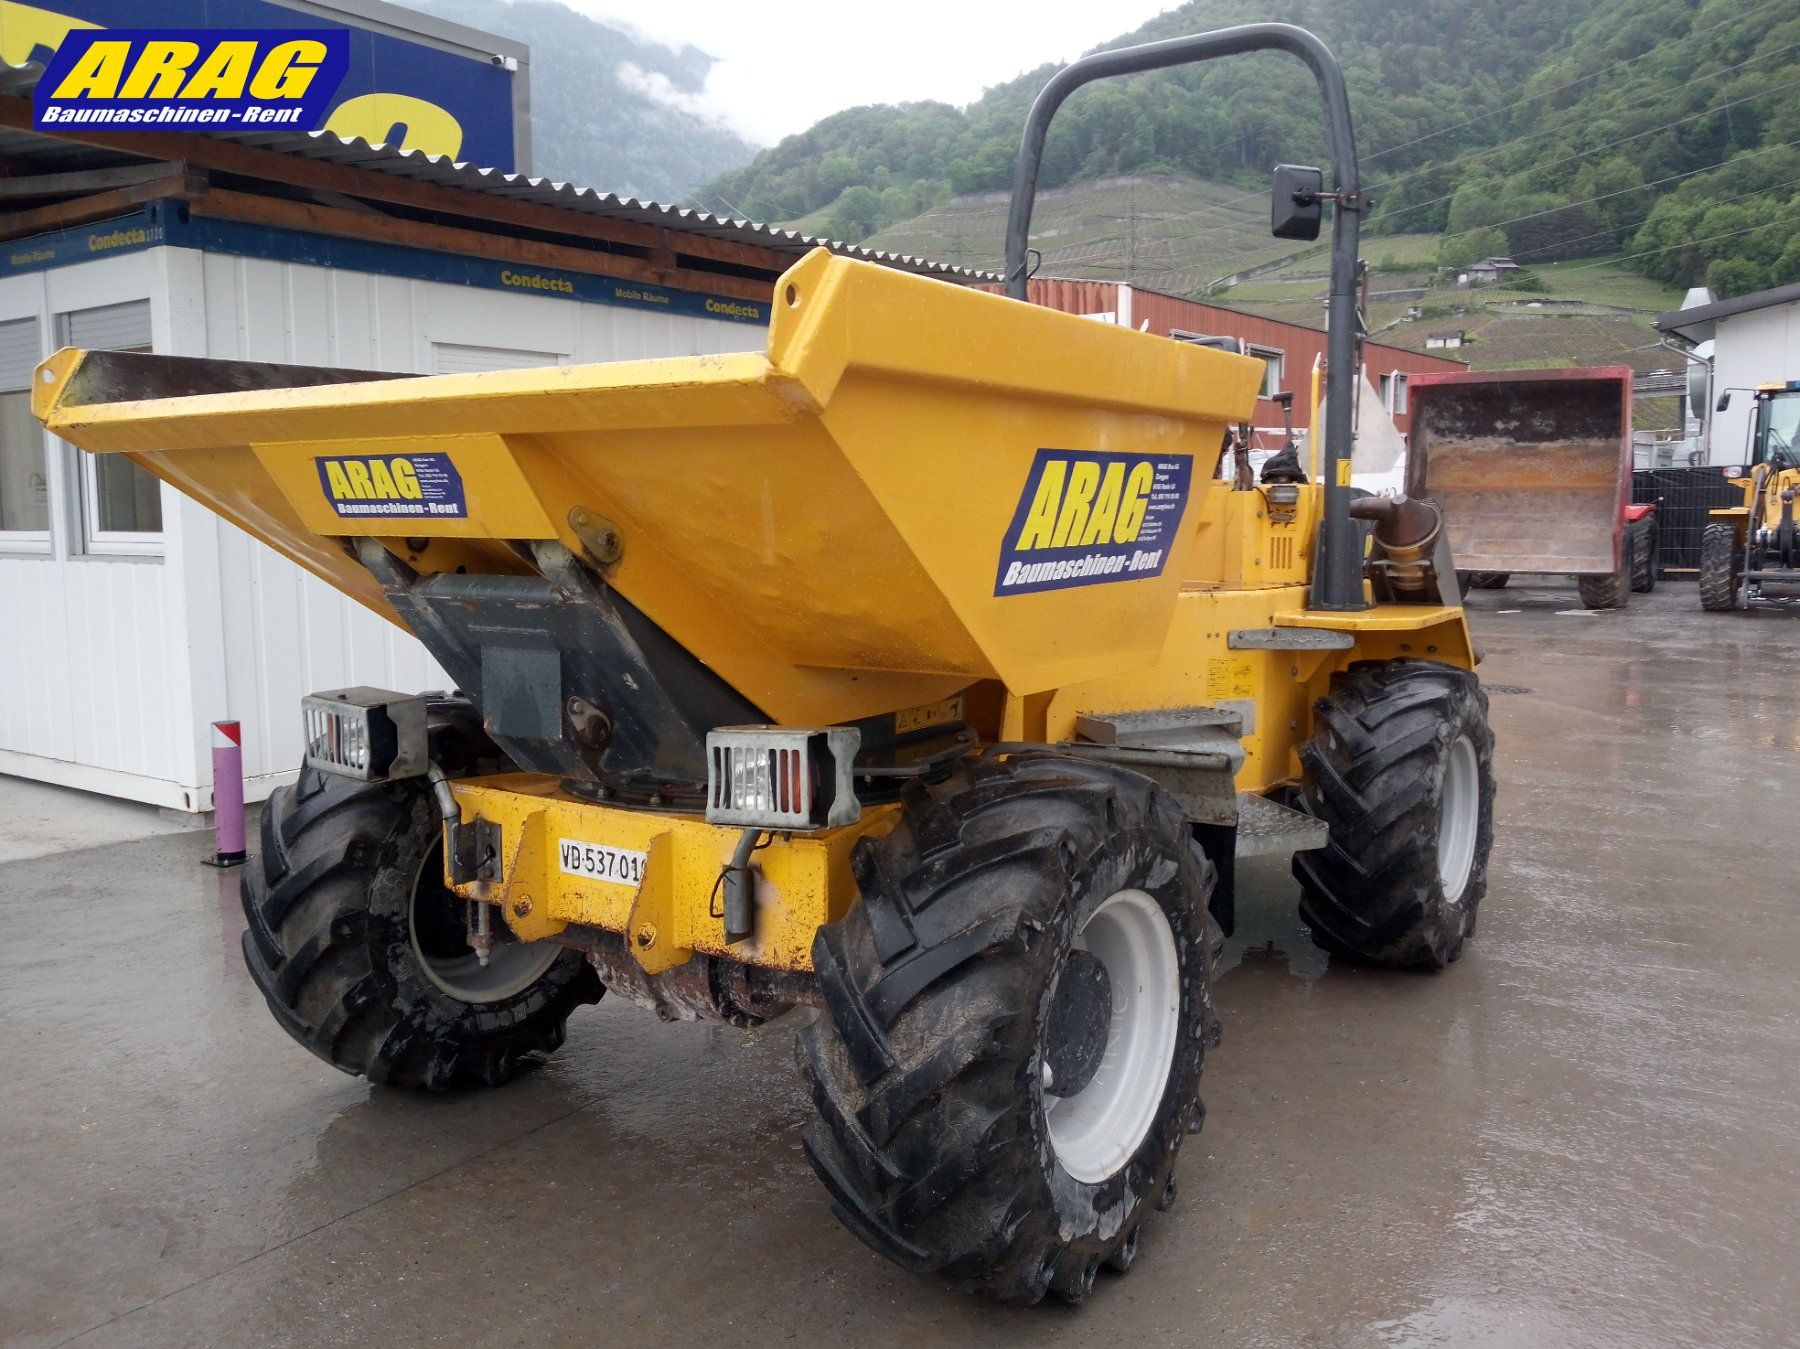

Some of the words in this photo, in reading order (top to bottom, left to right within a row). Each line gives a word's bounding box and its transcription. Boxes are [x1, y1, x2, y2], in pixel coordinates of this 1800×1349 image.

[88, 230, 145, 251] Condecta
[501, 270, 574, 293] Condecta
[615, 287, 641, 300] Mobile
[705, 298, 760, 318] Condecta
[324, 457, 424, 499] ARAG
[1014, 460, 1154, 551] ARAG
